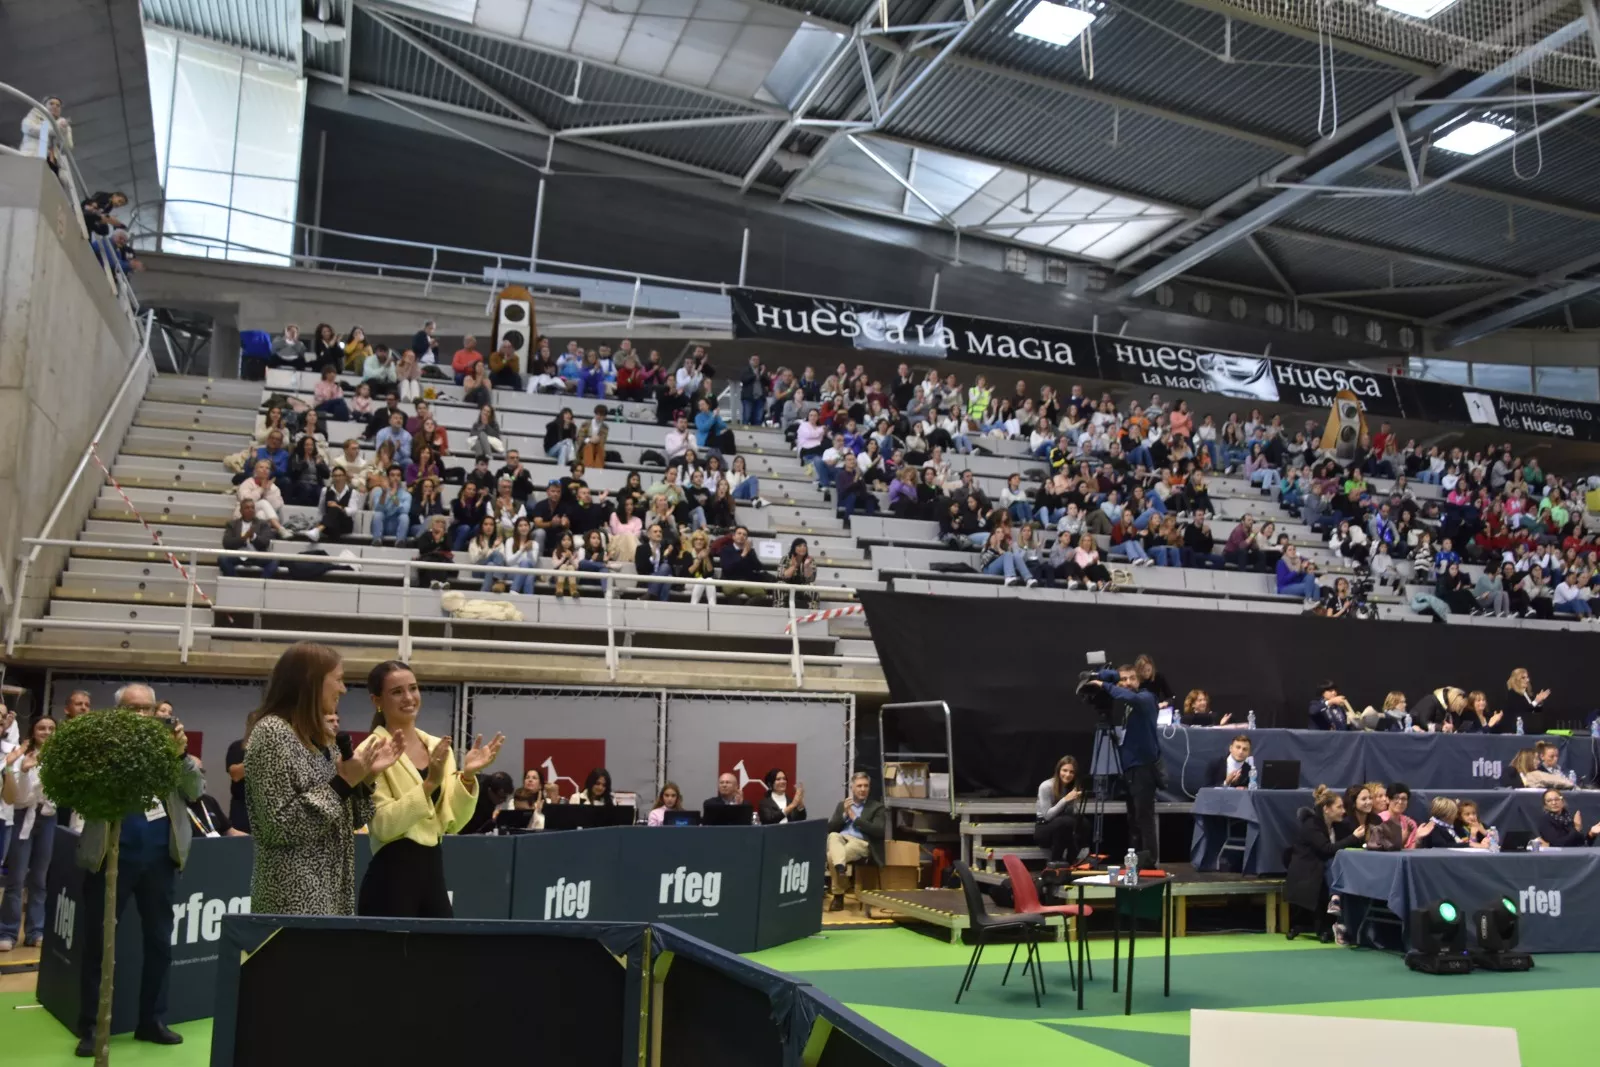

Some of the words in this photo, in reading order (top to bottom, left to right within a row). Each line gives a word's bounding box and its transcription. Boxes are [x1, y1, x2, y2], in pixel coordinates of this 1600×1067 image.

[1275, 363, 1383, 398] Huesca
[1499, 396, 1592, 421] Ayuntamiento
[1503, 415, 1520, 429] de
[1522, 416, 1575, 437] Huesca
[1472, 757, 1502, 779] rfeg
[658, 866, 722, 907] rfeg
[779, 858, 810, 894] rfeg
[544, 877, 592, 920] rfeg
[1519, 886, 1562, 917] rfeg
[54, 887, 76, 950] rfeg
